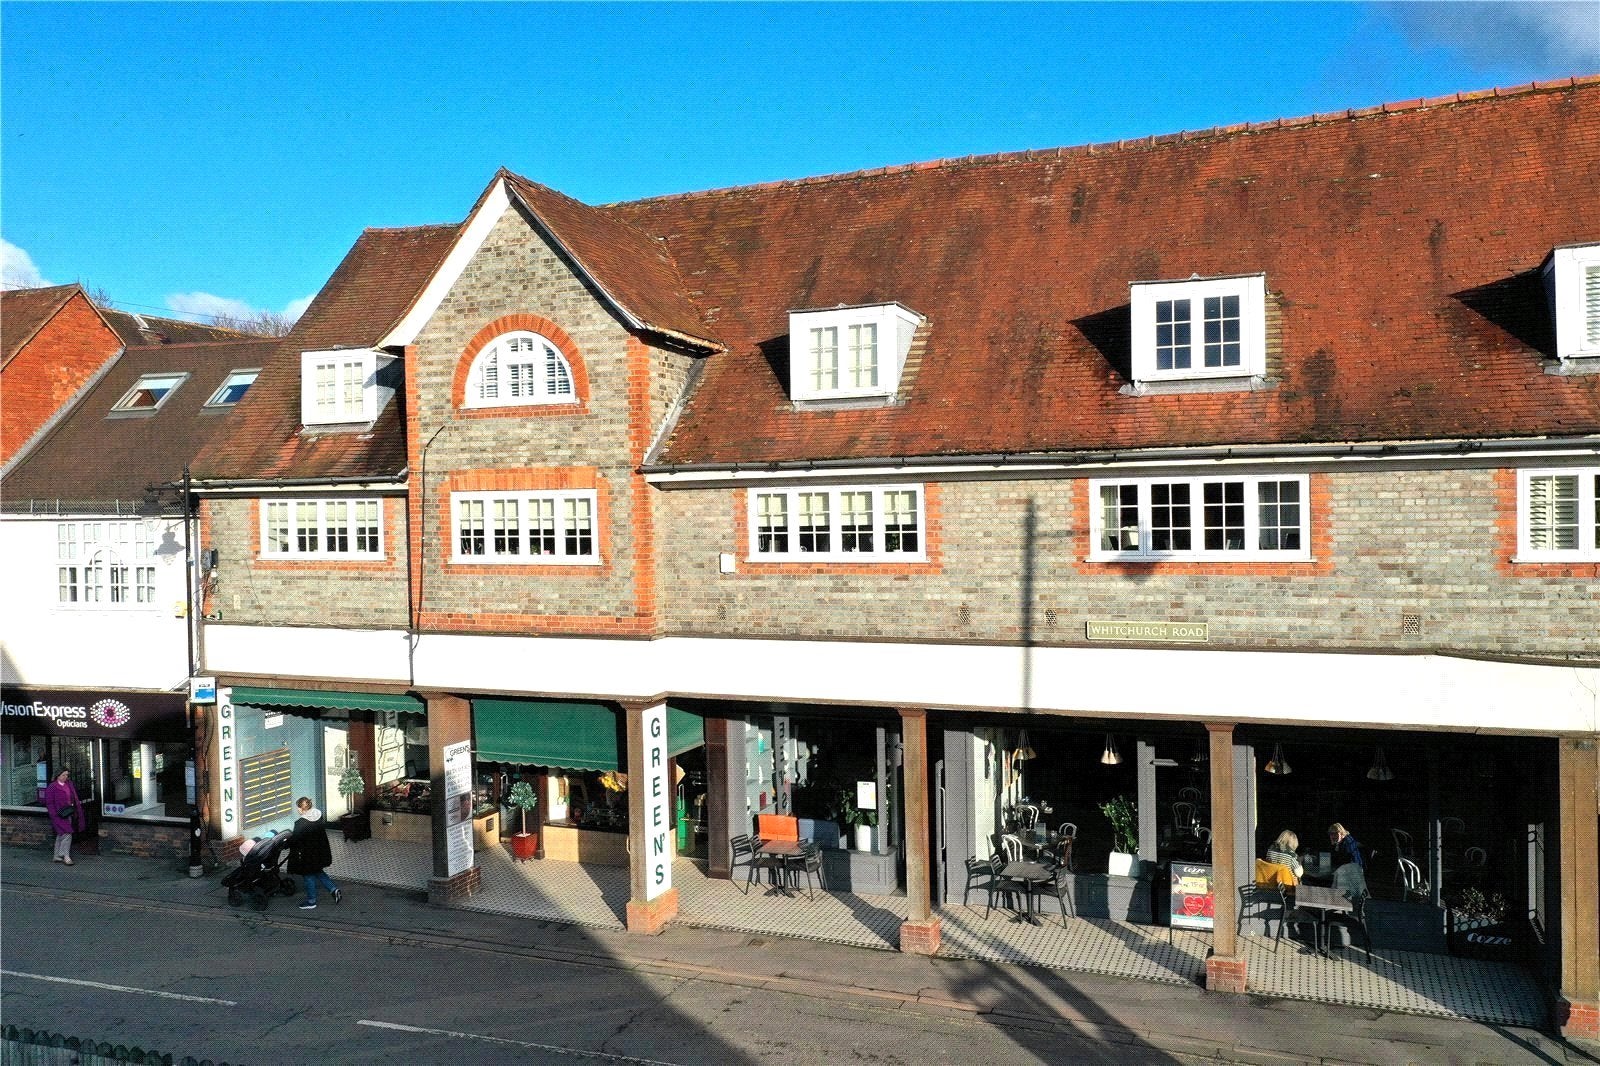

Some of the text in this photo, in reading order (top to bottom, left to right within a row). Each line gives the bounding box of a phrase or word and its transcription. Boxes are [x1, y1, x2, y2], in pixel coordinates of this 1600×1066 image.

[1091, 625, 1204, 637] WHITCHURCH ROAD
[57, 719, 88, 729] Opticians
[650, 717, 665, 885] GREEN'S
